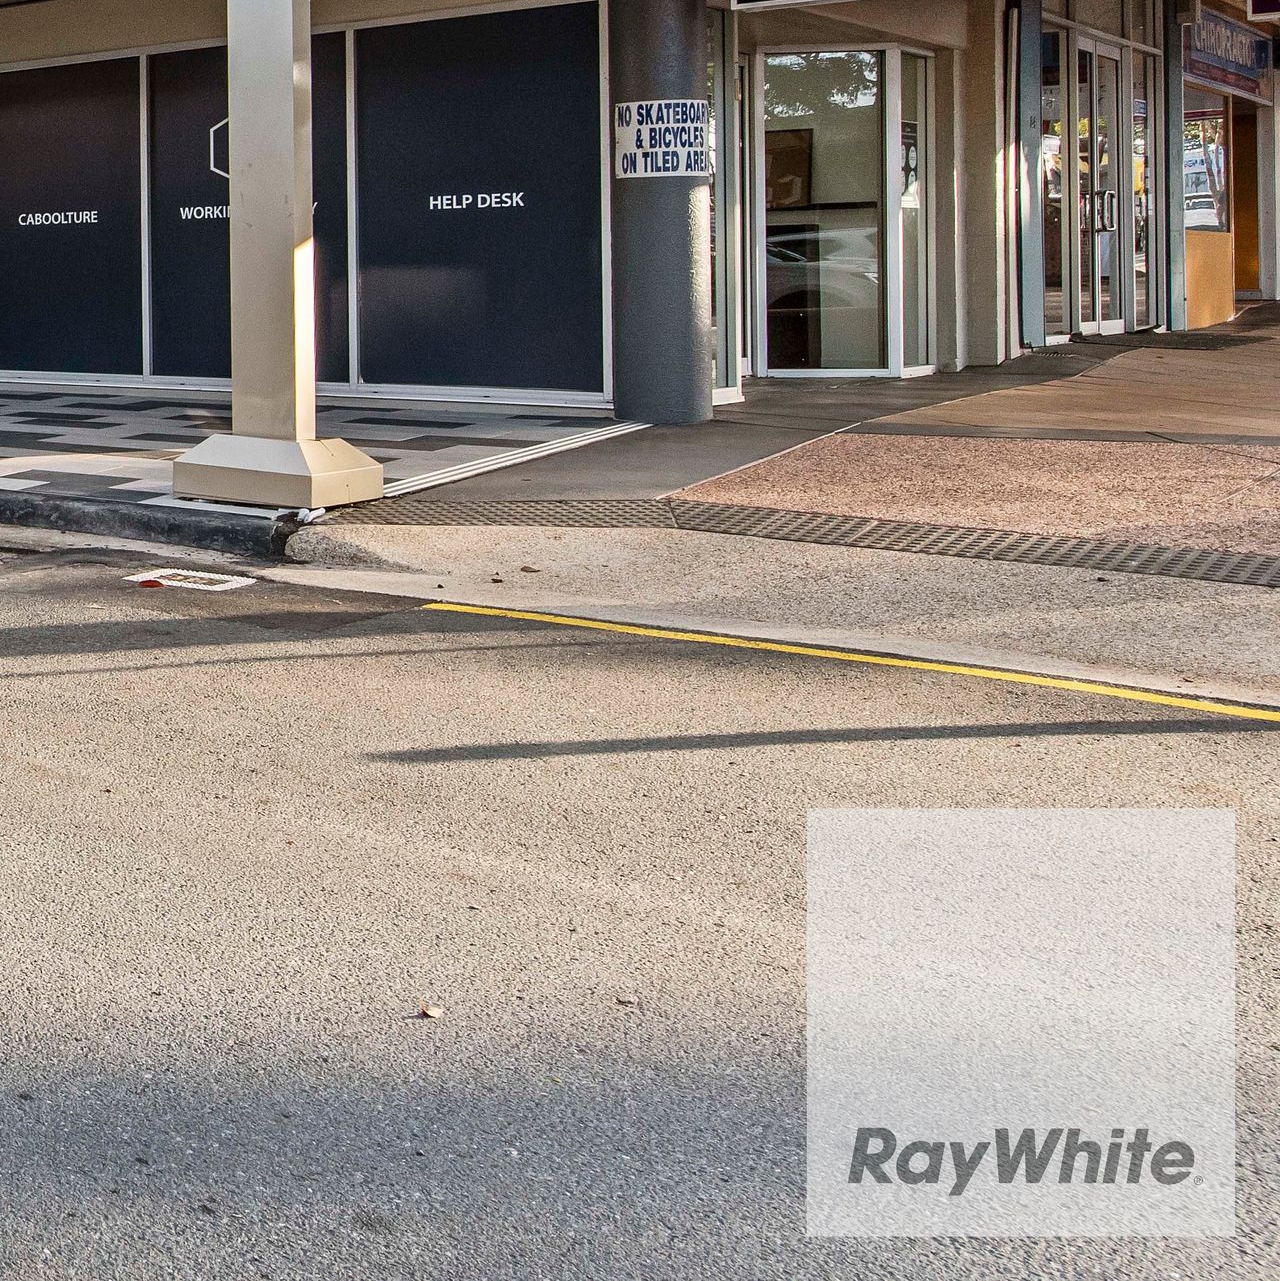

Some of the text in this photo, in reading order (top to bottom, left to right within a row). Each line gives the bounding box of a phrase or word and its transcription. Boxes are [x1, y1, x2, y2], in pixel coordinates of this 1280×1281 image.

[617, 104, 631, 128] NO
[635, 126, 704, 149] & BICYCLES
[621, 152, 637, 174] ON
[642, 150, 680, 173] TILED
[429, 192, 525, 210] HELP DESK
[18, 210, 98, 226] CABOOLTURE
[180, 205, 230, 220] WORKI
